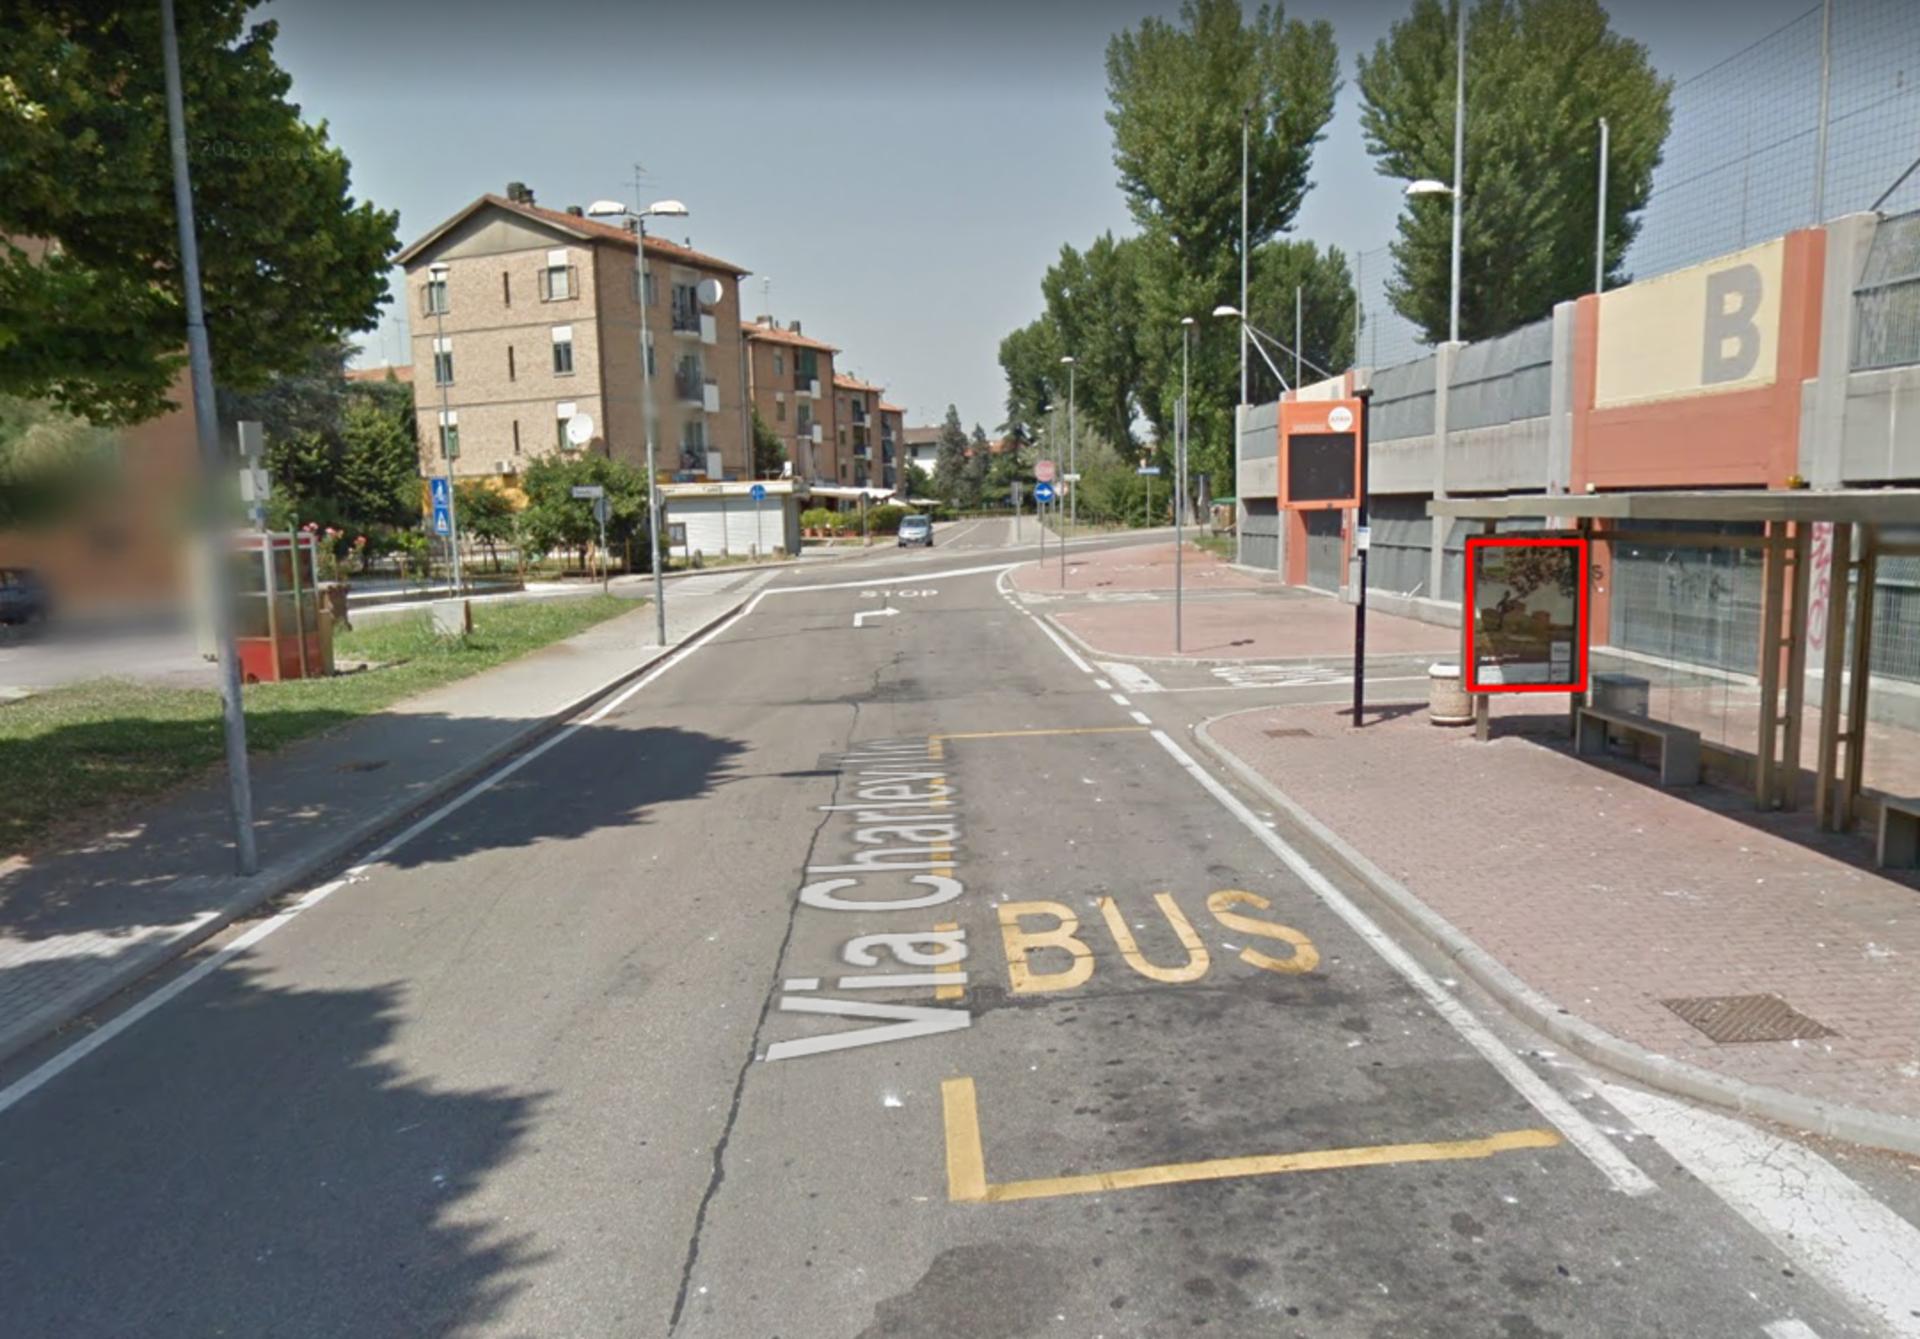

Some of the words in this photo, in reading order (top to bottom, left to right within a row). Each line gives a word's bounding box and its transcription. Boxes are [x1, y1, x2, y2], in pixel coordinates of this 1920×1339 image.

[1701, 263, 1763, 385] B
[860, 588, 939, 598] STOP
[997, 889, 1321, 994] BUS
